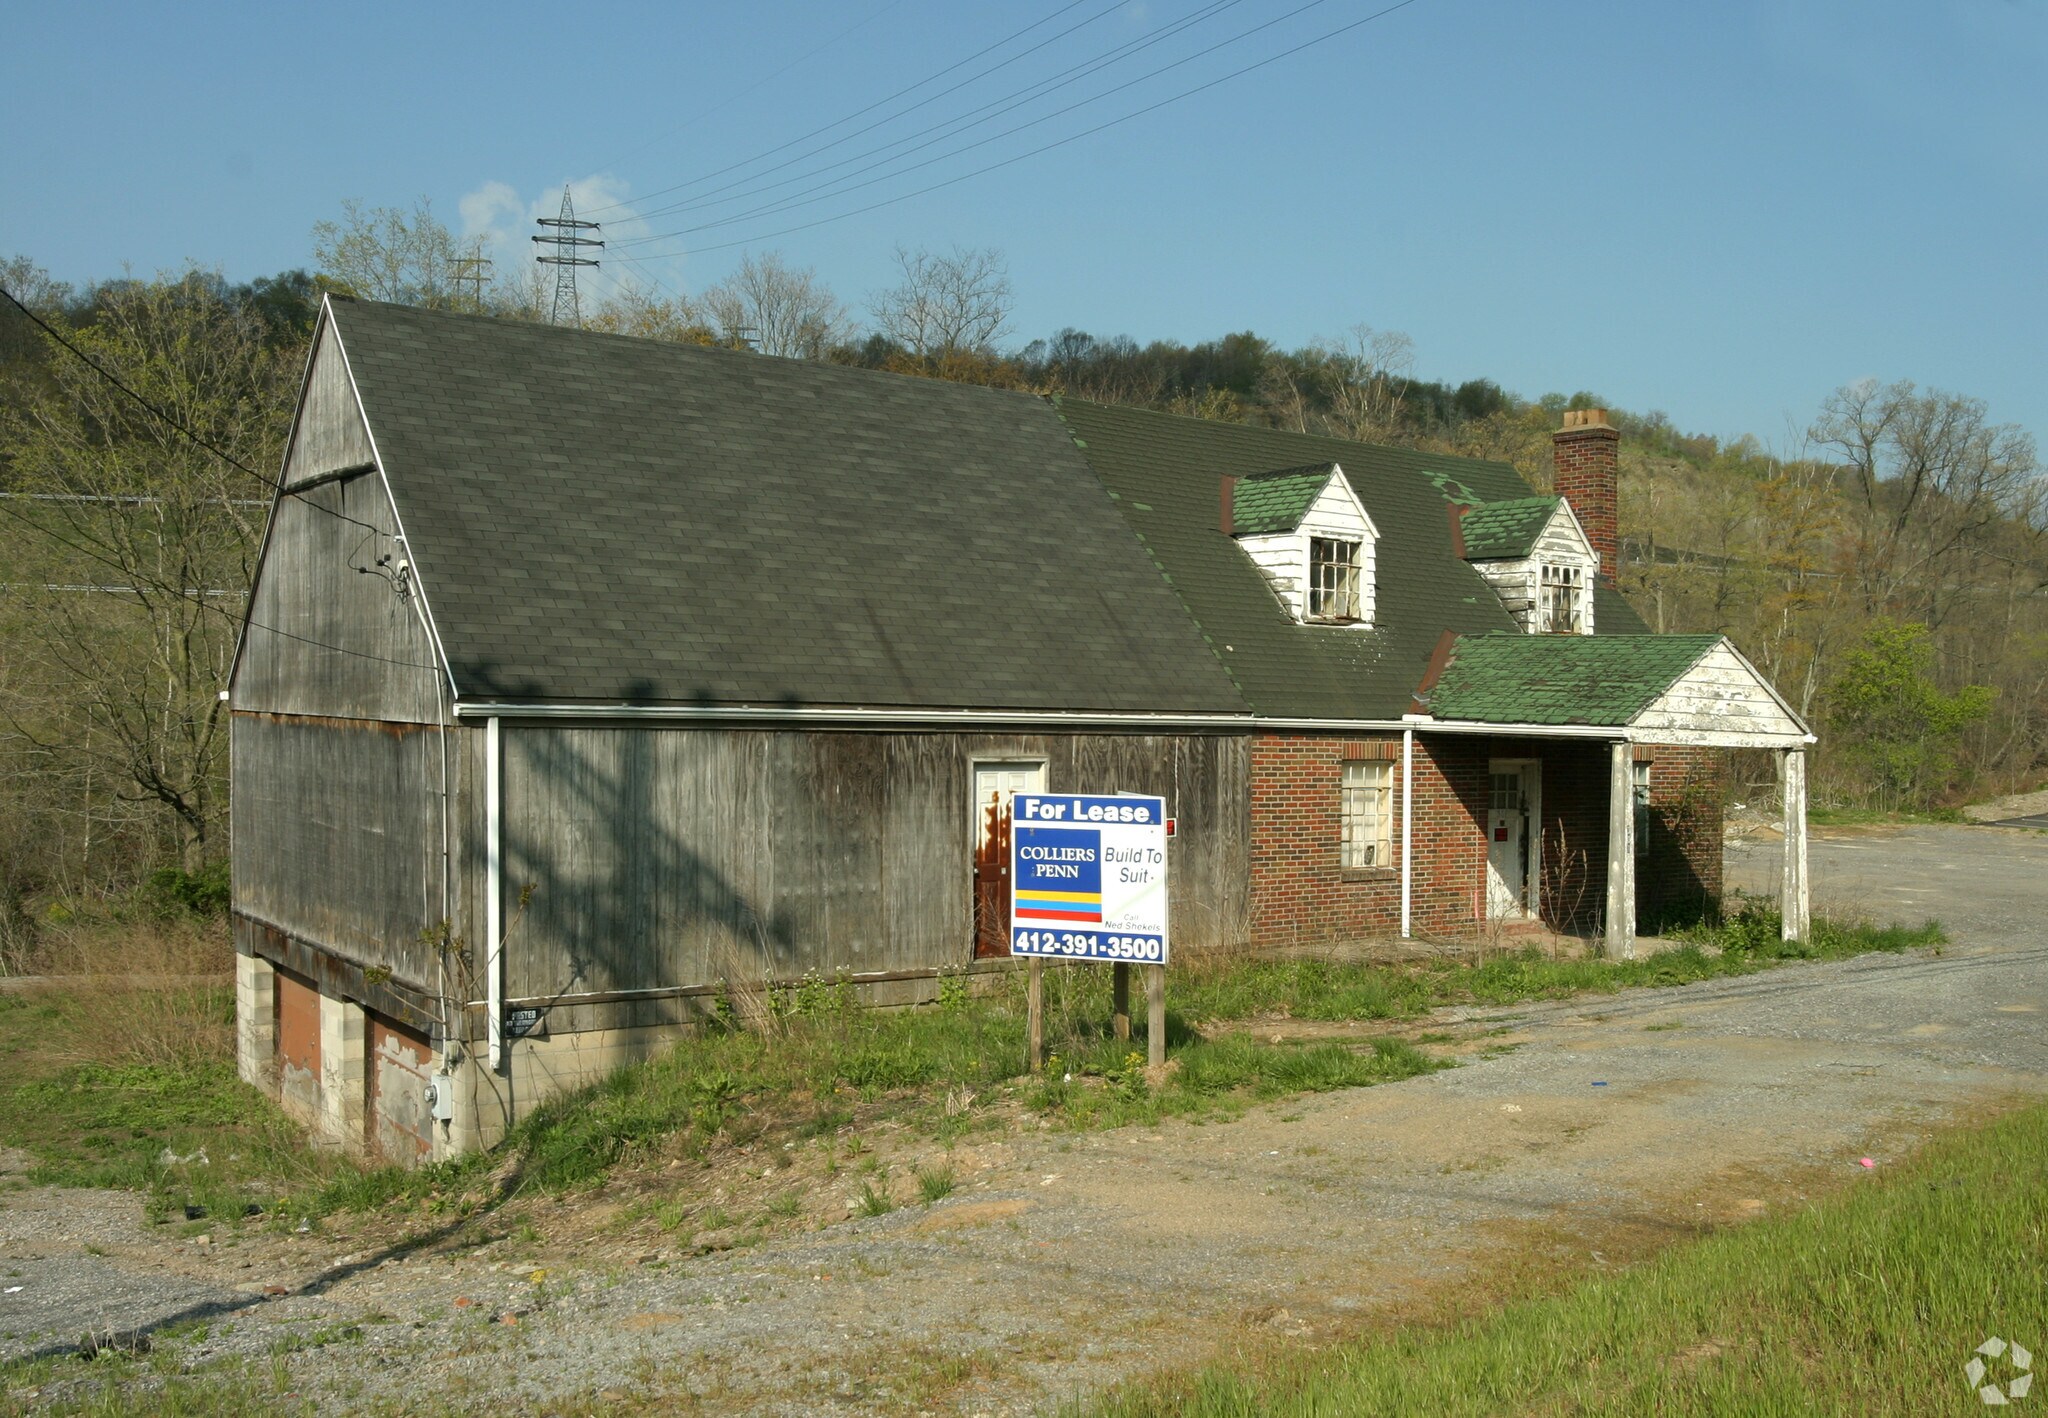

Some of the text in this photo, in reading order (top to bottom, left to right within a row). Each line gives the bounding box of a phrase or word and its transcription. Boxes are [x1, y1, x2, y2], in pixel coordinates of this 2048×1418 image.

[1025, 798, 1150, 823] For Lease
[1020, 846, 1096, 862] COLLIERS
[1105, 847, 1163, 864] Build To
[1036, 864, 1079, 879] PENN
[1119, 867, 1148, 884] Suit
[1105, 920, 1123, 930] Ned
[1124, 913, 1139, 921] Call
[1016, 931, 1160, 960] 412-391-3500
